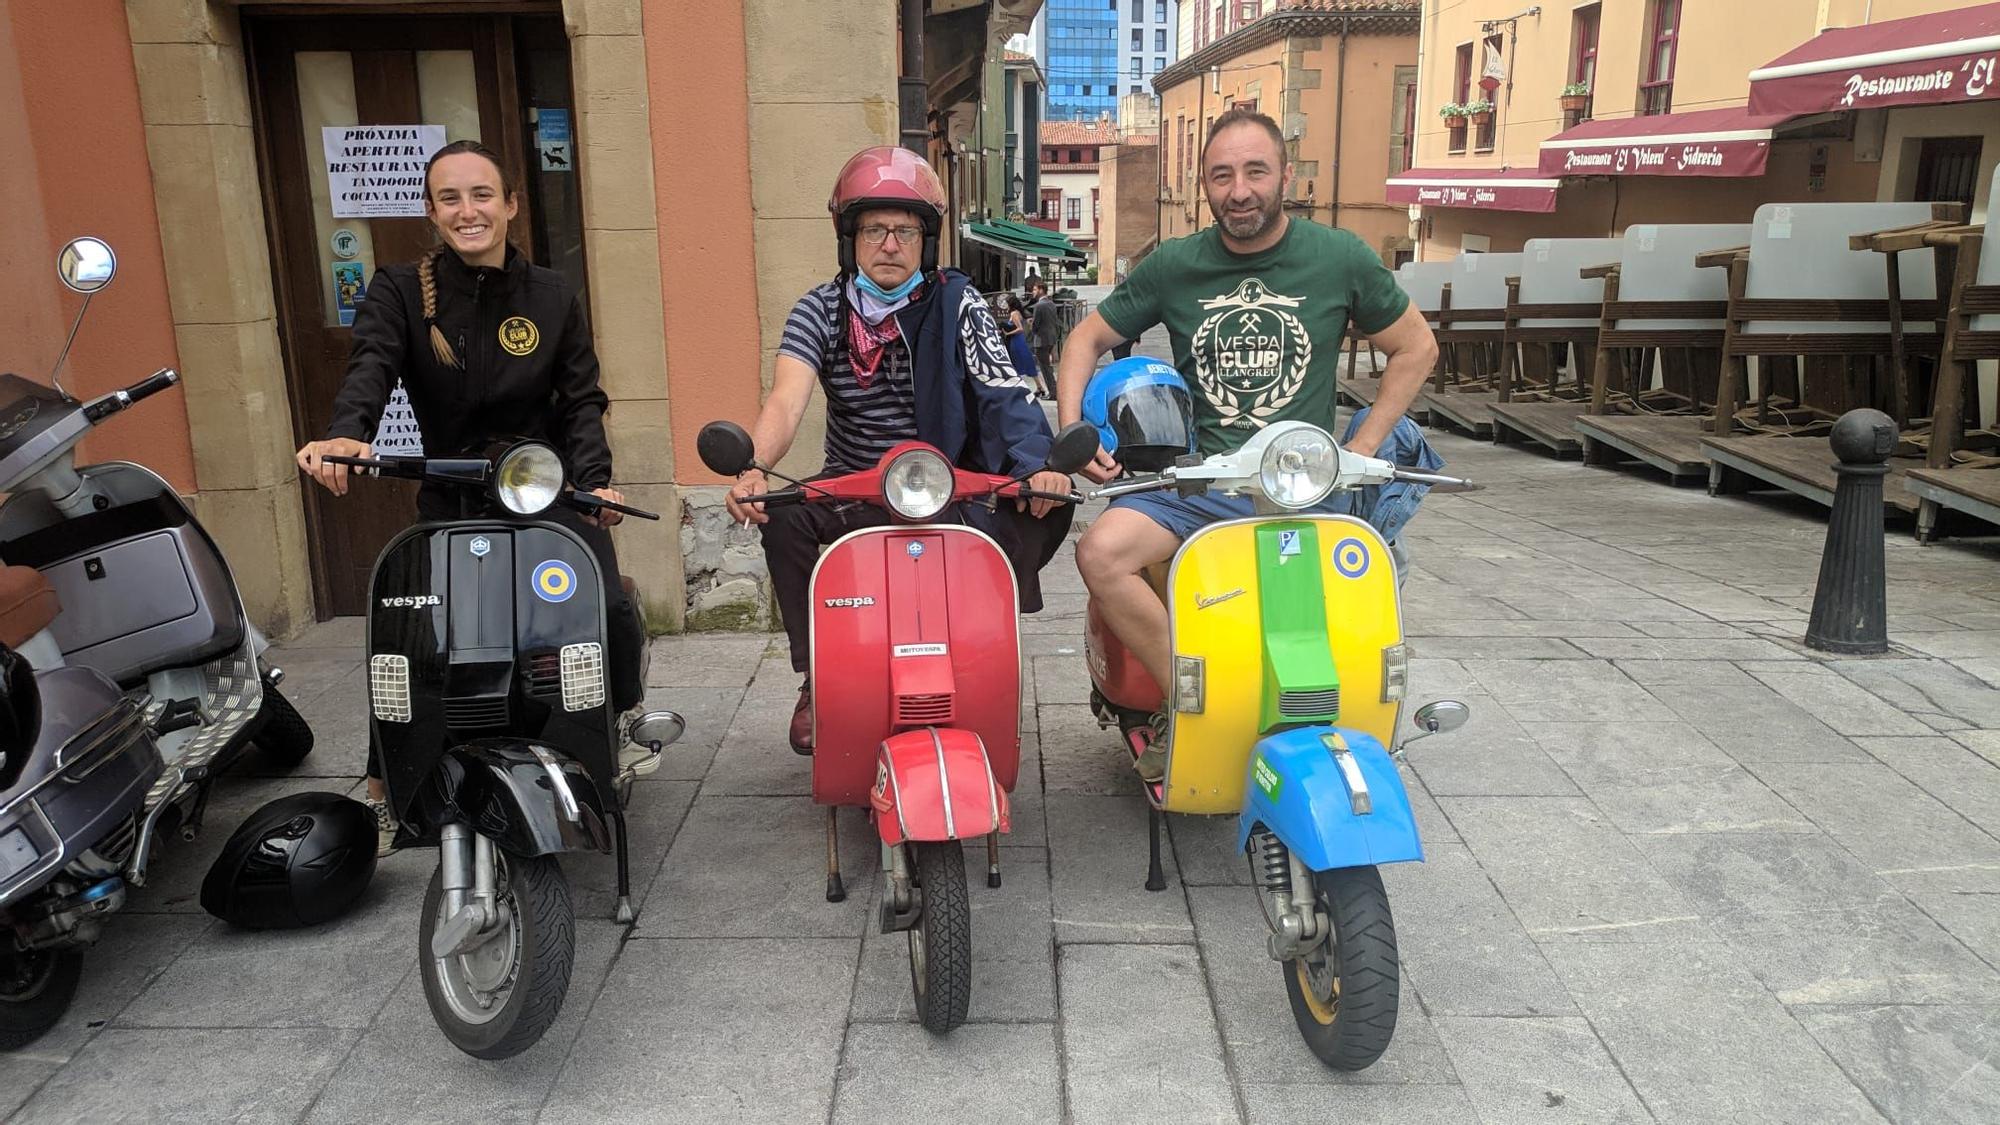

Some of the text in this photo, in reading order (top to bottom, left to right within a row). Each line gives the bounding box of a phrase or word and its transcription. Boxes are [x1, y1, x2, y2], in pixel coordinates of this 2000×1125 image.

[1841, 69, 1953, 106] Restaurante
[344, 127, 418, 140] PRÓXIMA
[341, 145, 424, 157] APERTURA
[1565, 150, 1612, 171] Restaurante
[329, 161, 429, 173] RESTAURANT
[351, 177, 423, 187] TANDOORI
[341, 191, 425, 201] COCINA INDI
[1218, 335, 1281, 350] VESPA
[1220, 351, 1280, 368] CLUB
[1220, 368, 1279, 377] LLANGREU
[381, 595, 441, 609] vespa
[825, 596, 875, 608] vespa
